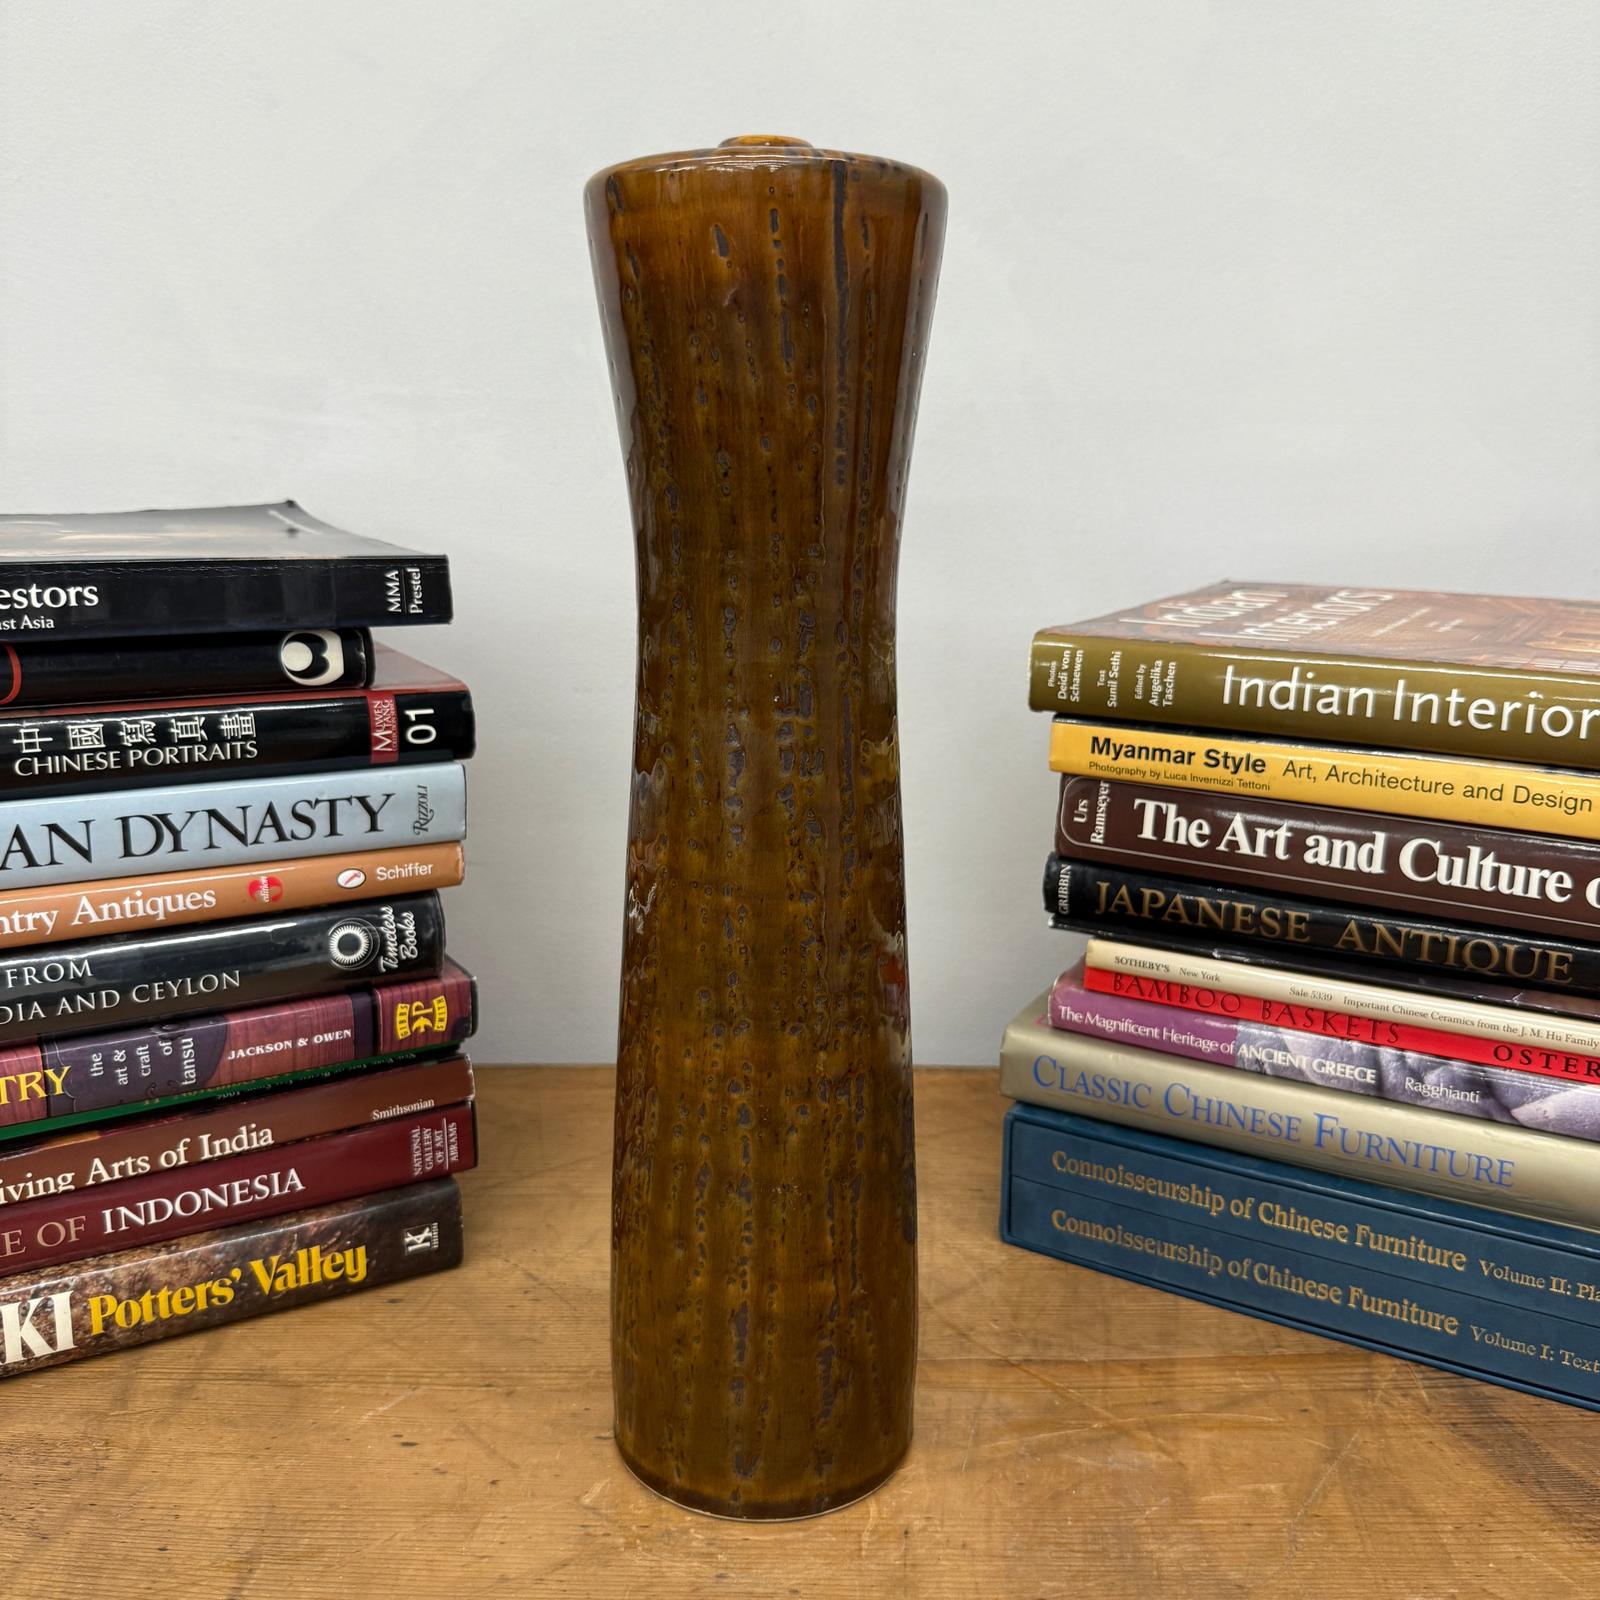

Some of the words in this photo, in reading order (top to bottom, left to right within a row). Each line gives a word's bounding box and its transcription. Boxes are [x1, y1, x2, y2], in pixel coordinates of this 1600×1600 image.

[384, 569, 402, 613] MMA
[406, 567, 423, 614] Prestel
[1119, 590, 1288, 627] Indian
[20, 614, 55, 630] Asia
[1197, 590, 1393, 642] Interiors
[1047, 660, 1057, 687] Photos
[1061, 650, 1071, 671] von
[1070, 649, 1083, 702] Schaewen
[1111, 651, 1122, 677] Sethi
[1138, 664, 1147, 675] by
[1058, 672, 1069, 700] Deidi
[1107, 677, 1118, 708] Sunil
[1135, 675, 1144, 700] Edited
[1149, 660, 1162, 707] Angelika
[1163, 661, 1176, 707] Taschen
[1223, 664, 1374, 718] Indian
[1393, 679, 1600, 739] Interior
[404, 708, 437, 744] 01
[15, 751, 121, 777] CHINESE
[130, 740, 258, 768] PORTRAITS
[1088, 761, 1147, 778] Photography
[1149, 769, 1161, 780] by
[1163, 770, 1187, 782] Luca
[1190, 773, 1234, 787] Invernizzi
[1236, 778, 1271, 791] Tettoni
[1090, 736, 1196, 766] Myanmar
[1203, 748, 1266, 775] Style
[1282, 760, 1317, 784] Art,
[1325, 764, 1454, 796] Architecture
[1463, 783, 1503, 801] and
[1513, 785, 1593, 815] Design
[1073, 798, 1089, 823] Urs
[1090, 779, 1111, 845] Ramseyer
[0, 819, 96, 871] AN
[114, 793, 396, 859] DYNASTY
[1134, 798, 1211, 848] The
[1215, 812, 1293, 860] Art
[1303, 831, 1386, 874] and
[1399, 837, 1573, 903] Culture
[376, 862, 434, 881] Schiffer
[1058, 863, 1072, 914] GRIBBIN
[71, 889, 217, 927] Antiques
[378, 905, 398, 973] Timeless
[397, 911, 418, 960] Books
[1094, 881, 1310, 944] JAPANESE
[1334, 918, 1574, 985] ANTIQUE
[6, 959, 94, 989] FROM
[56, 989, 121, 1017] AND
[132, 970, 241, 1003] CEYLON
[399, 1005, 409, 1037] GIBBS
[436, 998, 446, 1029] SMITH
[1114, 955, 1170, 973] SOTHEBY'S
[1179, 967, 1199, 978] New
[1200, 971, 1221, 983] York
[1289, 987, 1309, 998] Sale
[1310, 990, 1333, 1002] 5339
[1343, 996, 1390, 1013] Important
[1392, 1004, 1429, 1018] Chinese
[1431, 1011, 1475, 1027] Ceramics
[1477, 1019, 1499, 1031] from
[1502, 1023, 1518, 1034] the
[1546, 1031, 1562, 1042] Hu
[1565, 1033, 1600, 1050] Family
[227, 1040, 293, 1060] JACKSON
[298, 1036, 309, 1048] &
[313, 1029, 352, 1043] OWEN
[1112, 973, 1241, 1013] BAMBOO
[1261, 999, 1400, 1045] BASKETS
[1493, 1044, 1600, 1078] OSTER
[91, 1052, 104, 1077] the
[114, 1049, 127, 1063] &
[136, 1044, 151, 1077] craft
[159, 1039, 173, 1056] of
[181, 1037, 196, 1085] tansu
[1058, 1004, 1083, 1023] The
[1085, 1011, 1160, 1039] Magnificent
[1163, 1026, 1218, 1052] Heritage
[1220, 1040, 1236, 1055] of
[1237, 1043, 1311, 1070] ANCIENT
[1312, 1058, 1377, 1084] GREECE
[1405, 1076, 1480, 1104] Ragghianti
[0, 1064, 71, 1106] TRY
[115, 1067, 128, 1086] art
[372, 1098, 435, 1121] Smithsonian
[1033, 1054, 1153, 1109] CLASSIC
[1164, 1082, 1302, 1143] CHINESE
[1313, 1112, 1515, 1188] FURNITURE
[86, 1155, 151, 1185] Arts
[160, 1138, 190, 1168] of
[199, 1123, 275, 1162] India
[411, 1125, 422, 1177] NATIONAL
[422, 1127, 433, 1170] GALLERY
[435, 1129, 444, 1148] ART
[436, 1149, 445, 1163] OF
[449, 1122, 458, 1161] ABRAMS
[37, 1215, 86, 1247] OF
[102, 1167, 306, 1235] INDONESIA
[1052, 1150, 1224, 1216] Connoisseurship
[1230, 1197, 1255, 1219] of
[1258, 1201, 1349, 1244] Chinese
[1354, 1222, 1467, 1273] Furniture
[1479, 1258, 1545, 1289] Volume
[1549, 1276, 1572, 1296] II:
[250, 1245, 368, 1297] Valley
[1051, 1209, 1223, 1276] Connoisseurship
[1228, 1258, 1252, 1280] of
[1253, 1262, 1342, 1305] Chinese
[1347, 1285, 1459, 1336] Furniture
[1470, 1324, 1537, 1356] Volume
